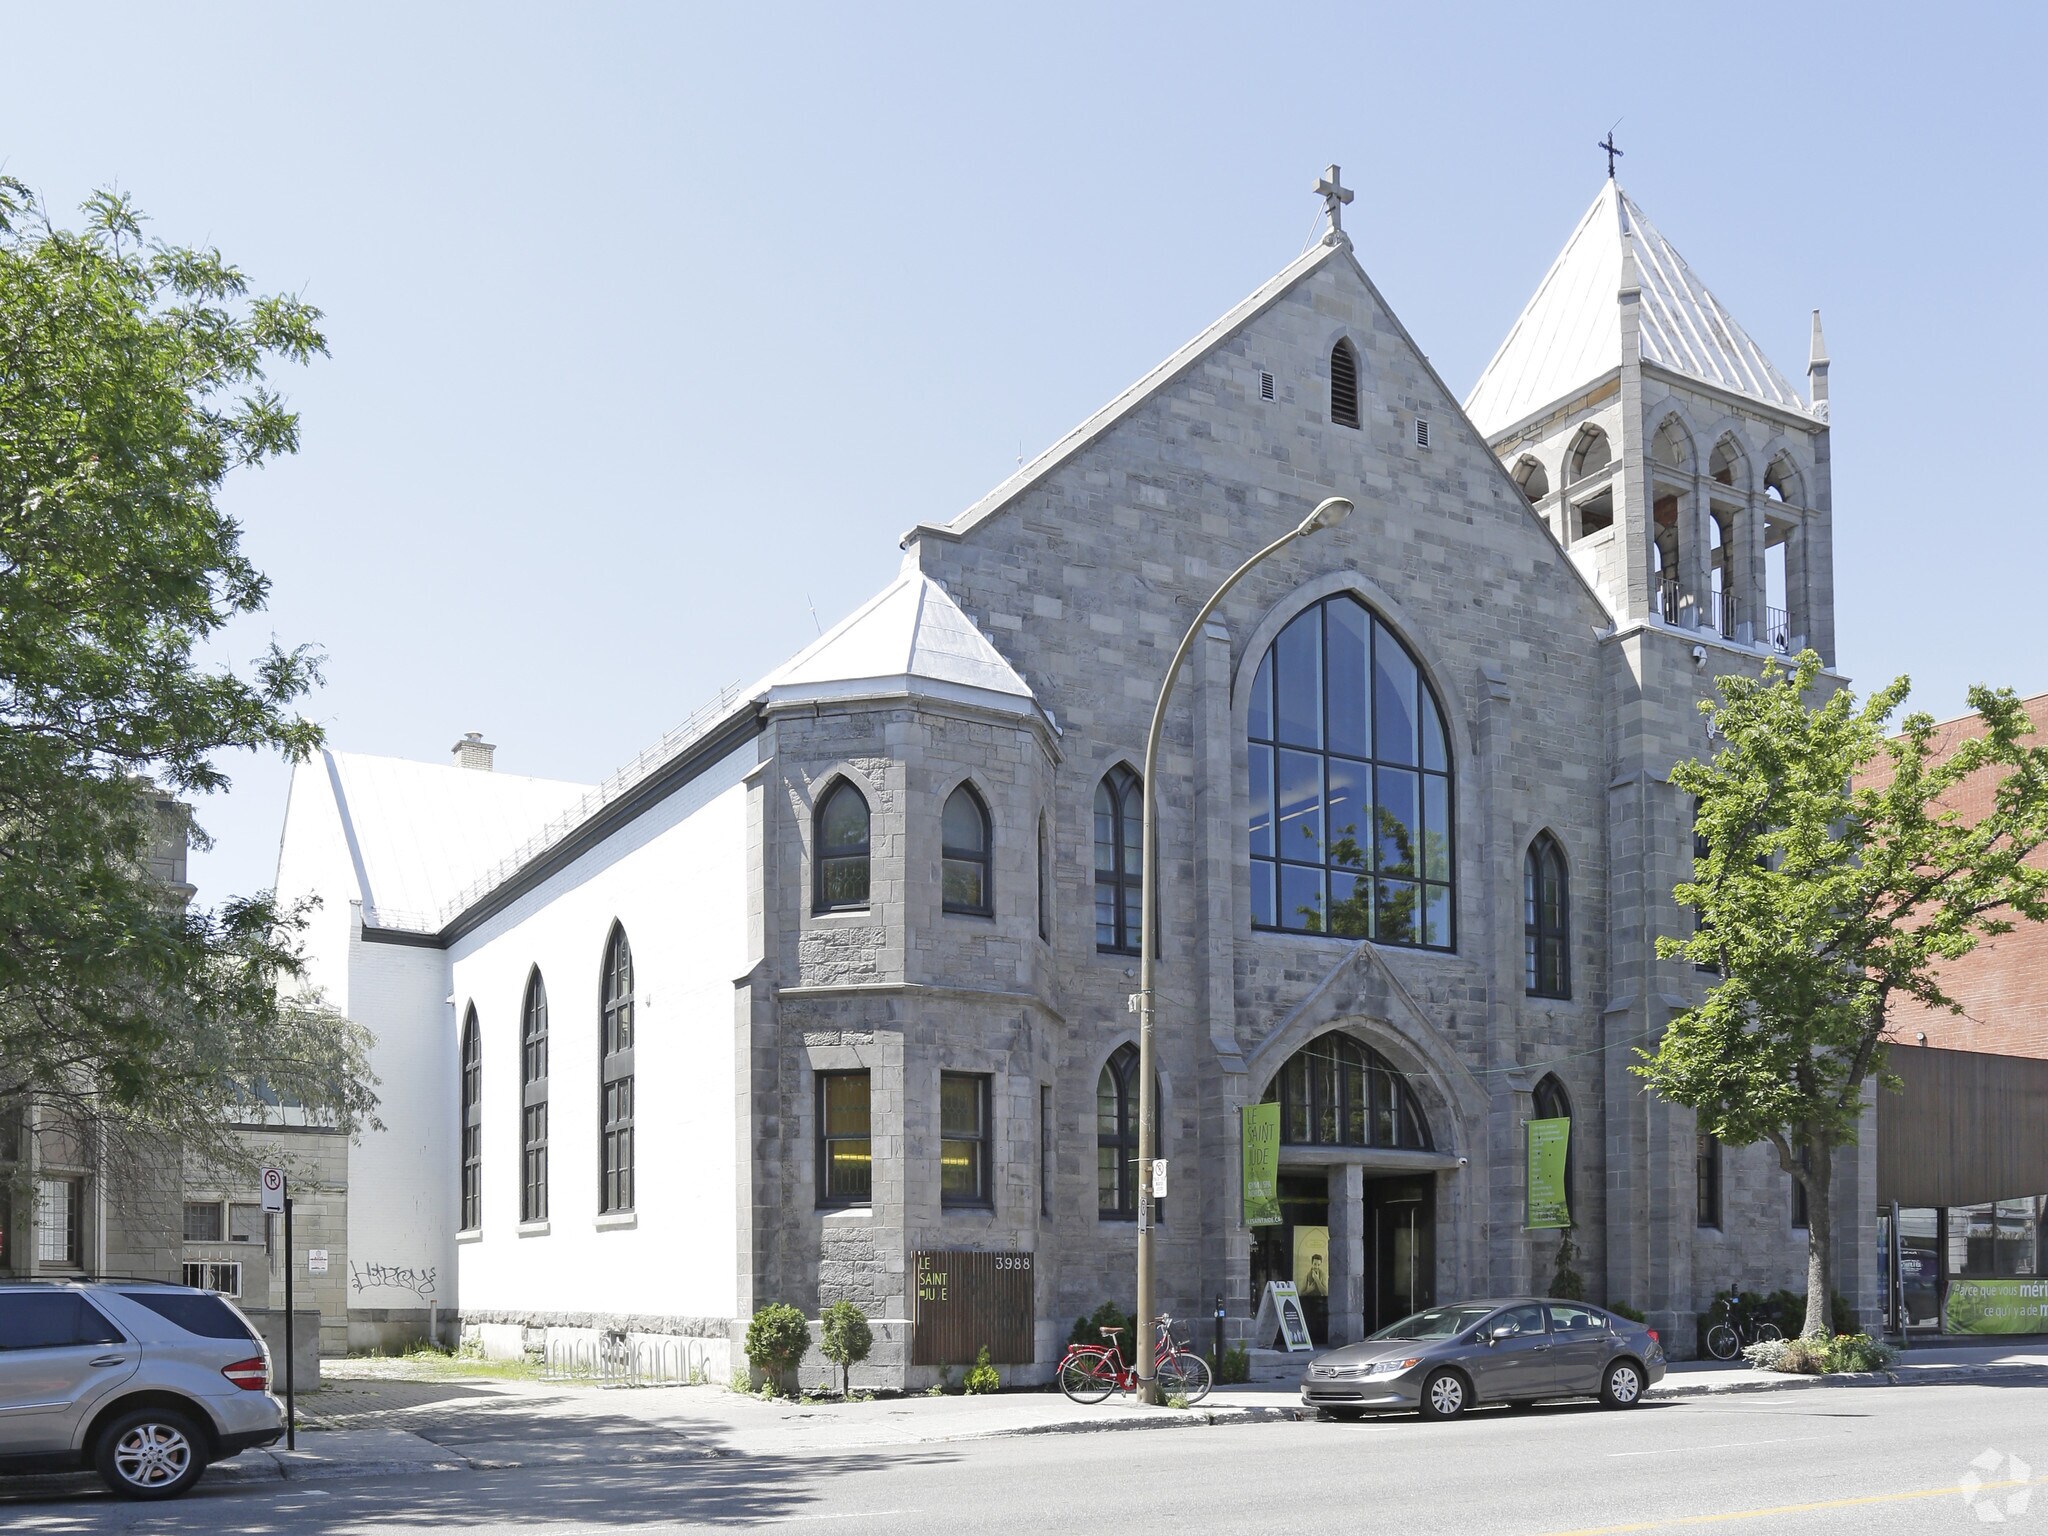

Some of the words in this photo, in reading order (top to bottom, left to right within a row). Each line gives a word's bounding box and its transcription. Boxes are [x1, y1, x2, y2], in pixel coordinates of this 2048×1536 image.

[1247, 1108, 1257, 1125] LE
[1247, 1123, 1275, 1143] SAINT
[1249, 1148, 1269, 1167] JUDE
[920, 1257, 930, 1270] LE
[995, 1257, 1031, 1270] 3988
[919, 1272, 947, 1286] SAINT
[924, 1288, 948, 1301] JUE
[1953, 1283, 1979, 1297] Parce
[1980, 1286, 1997, 1299] que
[1999, 1286, 2018, 1296] vous
[1983, 1306, 1994, 1317] ce
[2020, 1306, 2026, 1316] a
[2026, 1303, 2038, 1316] de
